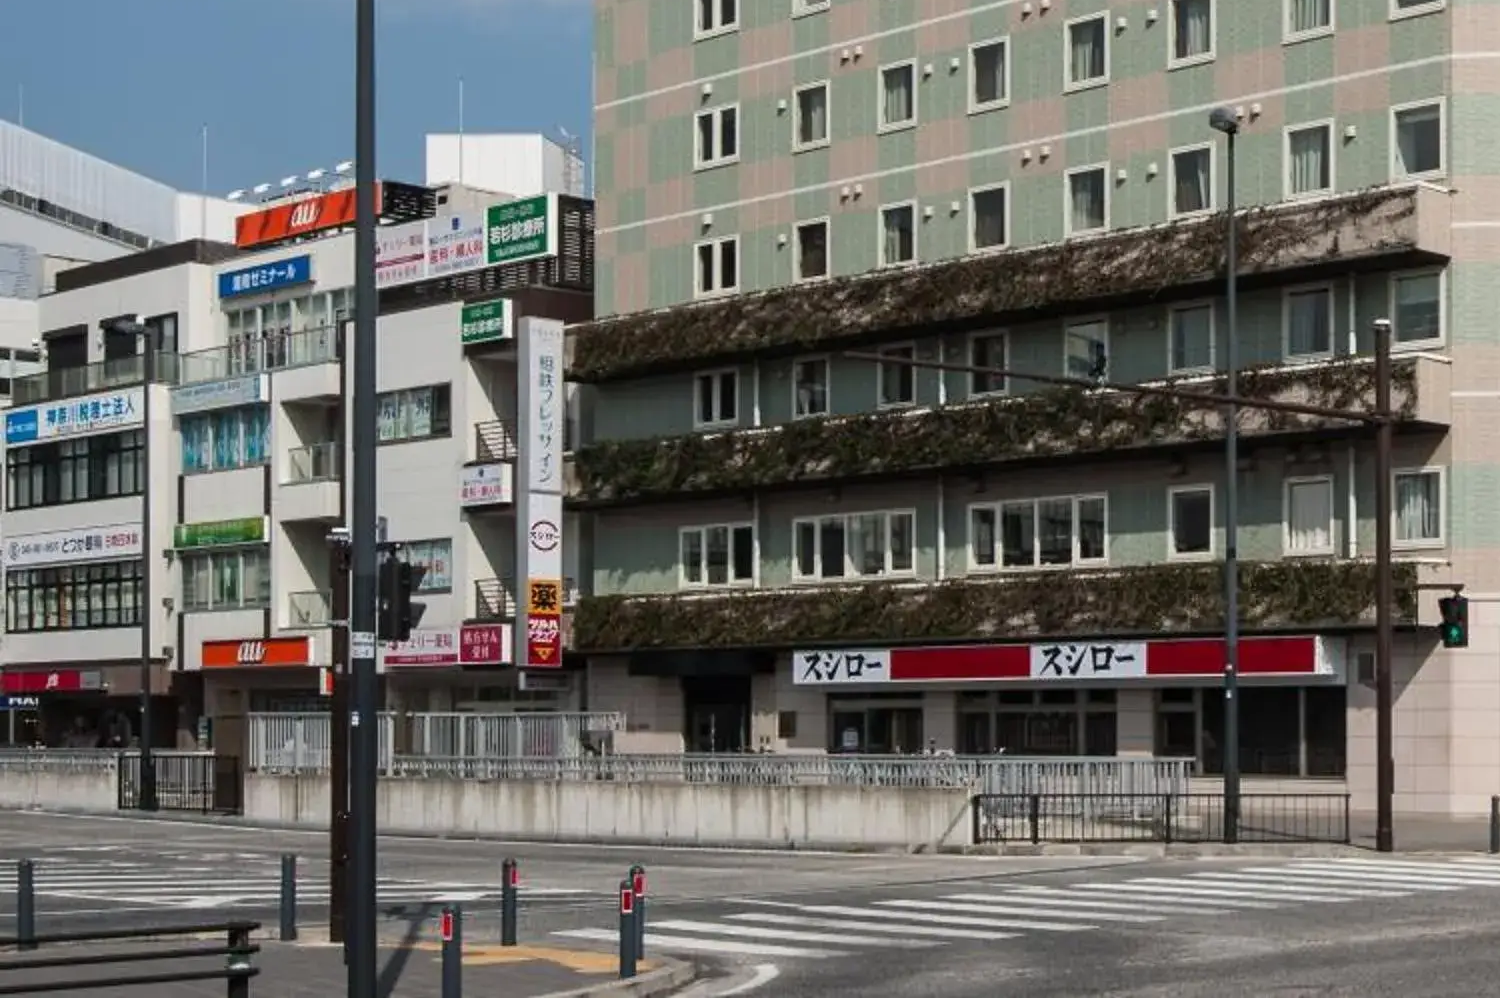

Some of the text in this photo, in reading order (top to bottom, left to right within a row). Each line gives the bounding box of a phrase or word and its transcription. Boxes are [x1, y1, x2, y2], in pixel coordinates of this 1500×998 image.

[290, 200, 321, 228] au
[539, 354, 555, 484] 相鉄フレッサイン
[530, 531, 560, 541] スシロー
[528, 619, 559, 632] ツルハ
[237, 642, 266, 662] au
[802, 652, 882, 680] スシロー
[1040, 642, 1135, 676] スシロー
